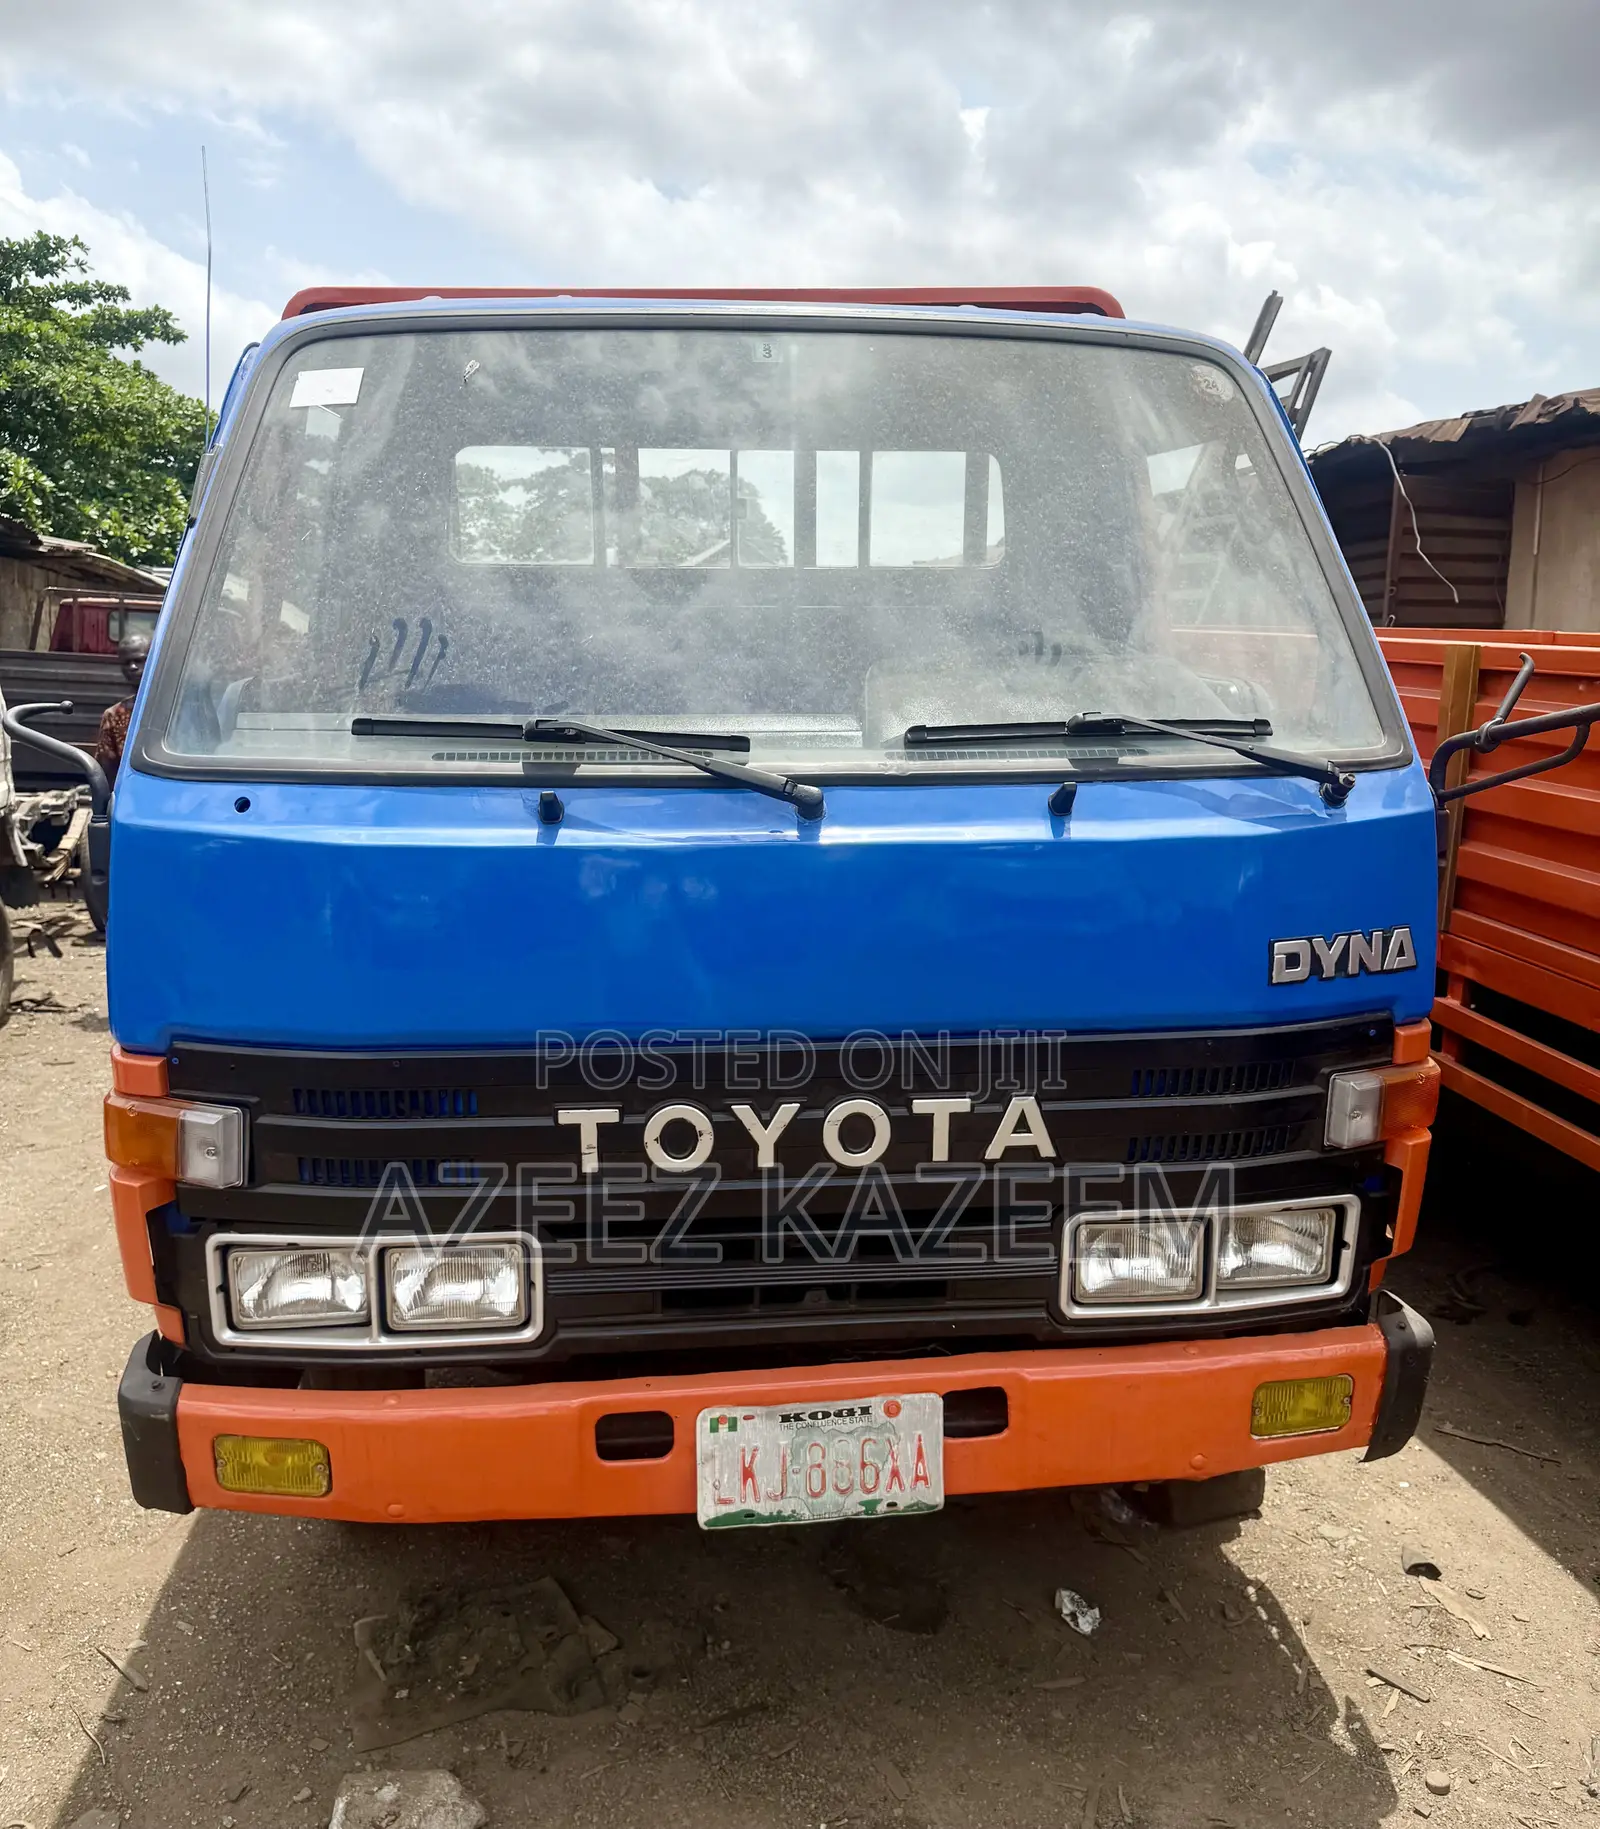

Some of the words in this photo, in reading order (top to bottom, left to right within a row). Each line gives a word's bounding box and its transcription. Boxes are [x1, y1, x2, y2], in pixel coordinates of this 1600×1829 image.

[1203, 378, 1220, 392] 24
[1270, 926, 1417, 984] DYNA
[556, 1095, 1058, 1174] TOYOTA
[779, 1405, 873, 1423] KOGI
[779, 1422, 794, 1431] THE
[795, 1417, 848, 1430] CONFLUENCE
[849, 1415, 873, 1424] STATE
